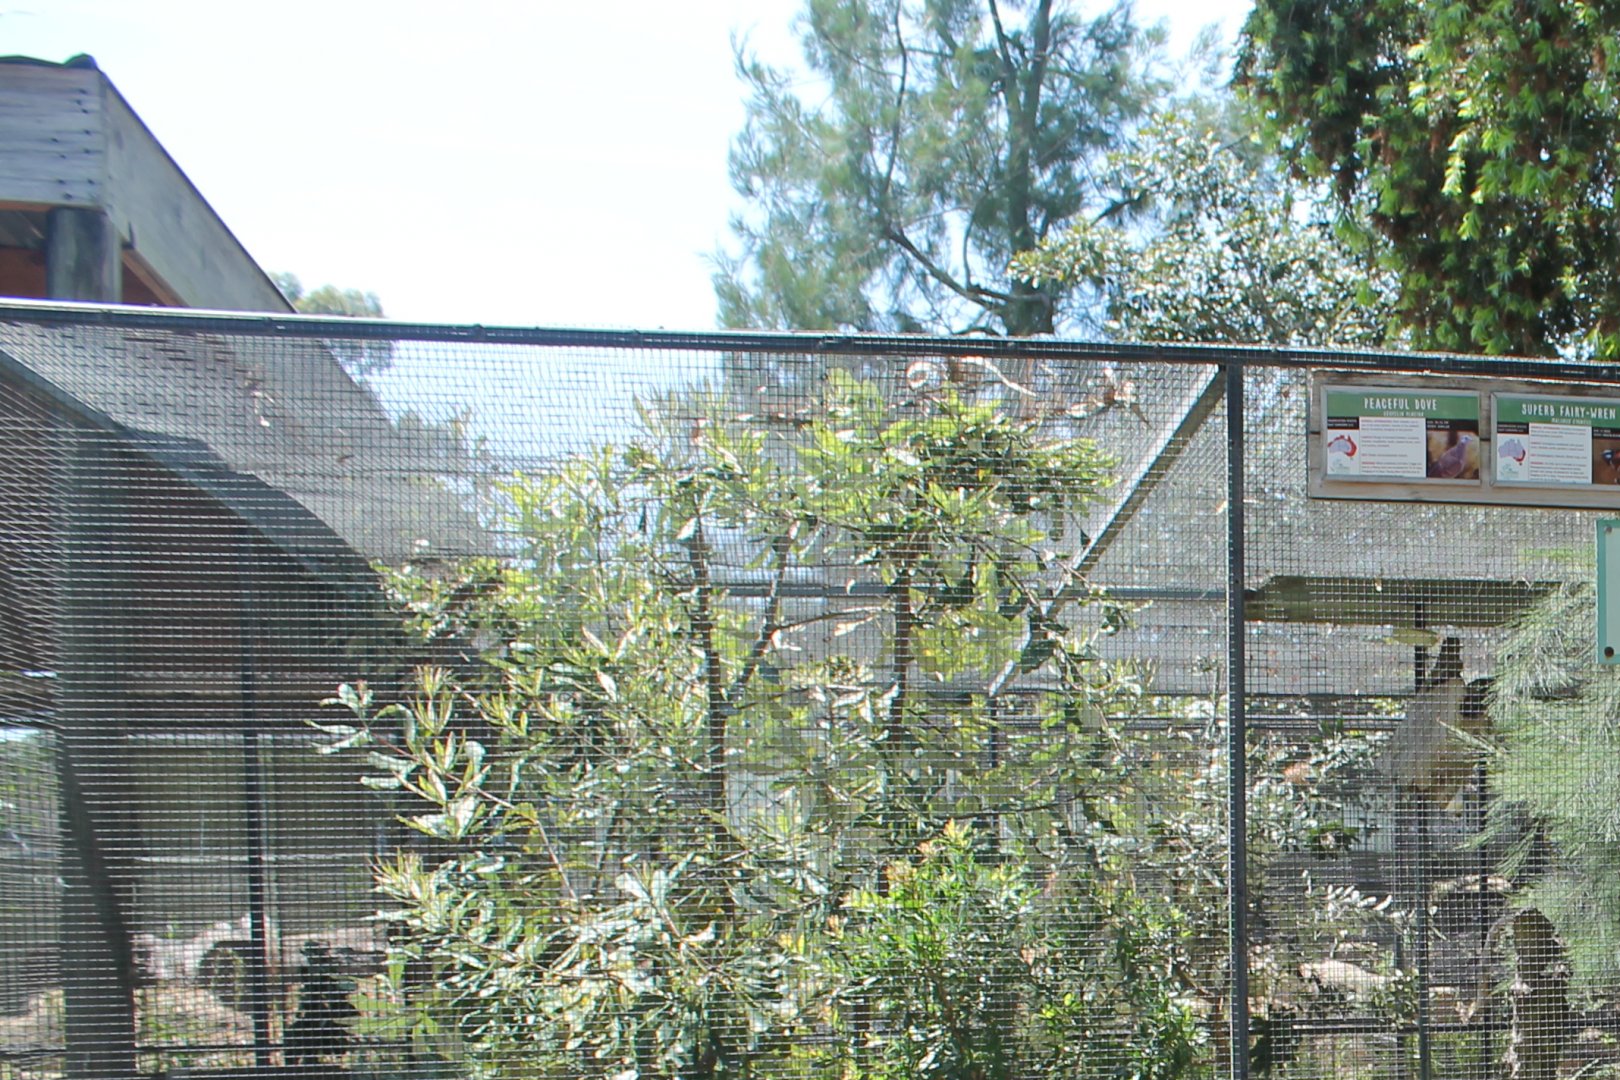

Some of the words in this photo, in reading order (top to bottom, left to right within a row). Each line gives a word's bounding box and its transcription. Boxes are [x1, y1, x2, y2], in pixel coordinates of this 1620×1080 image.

[1364, 397, 1410, 410] PEACEFUL
[1415, 399, 1438, 411] DOVE
[1521, 403, 1555, 417] SUPERB
[1560, 405, 1616, 420] FAIRY-WREN
